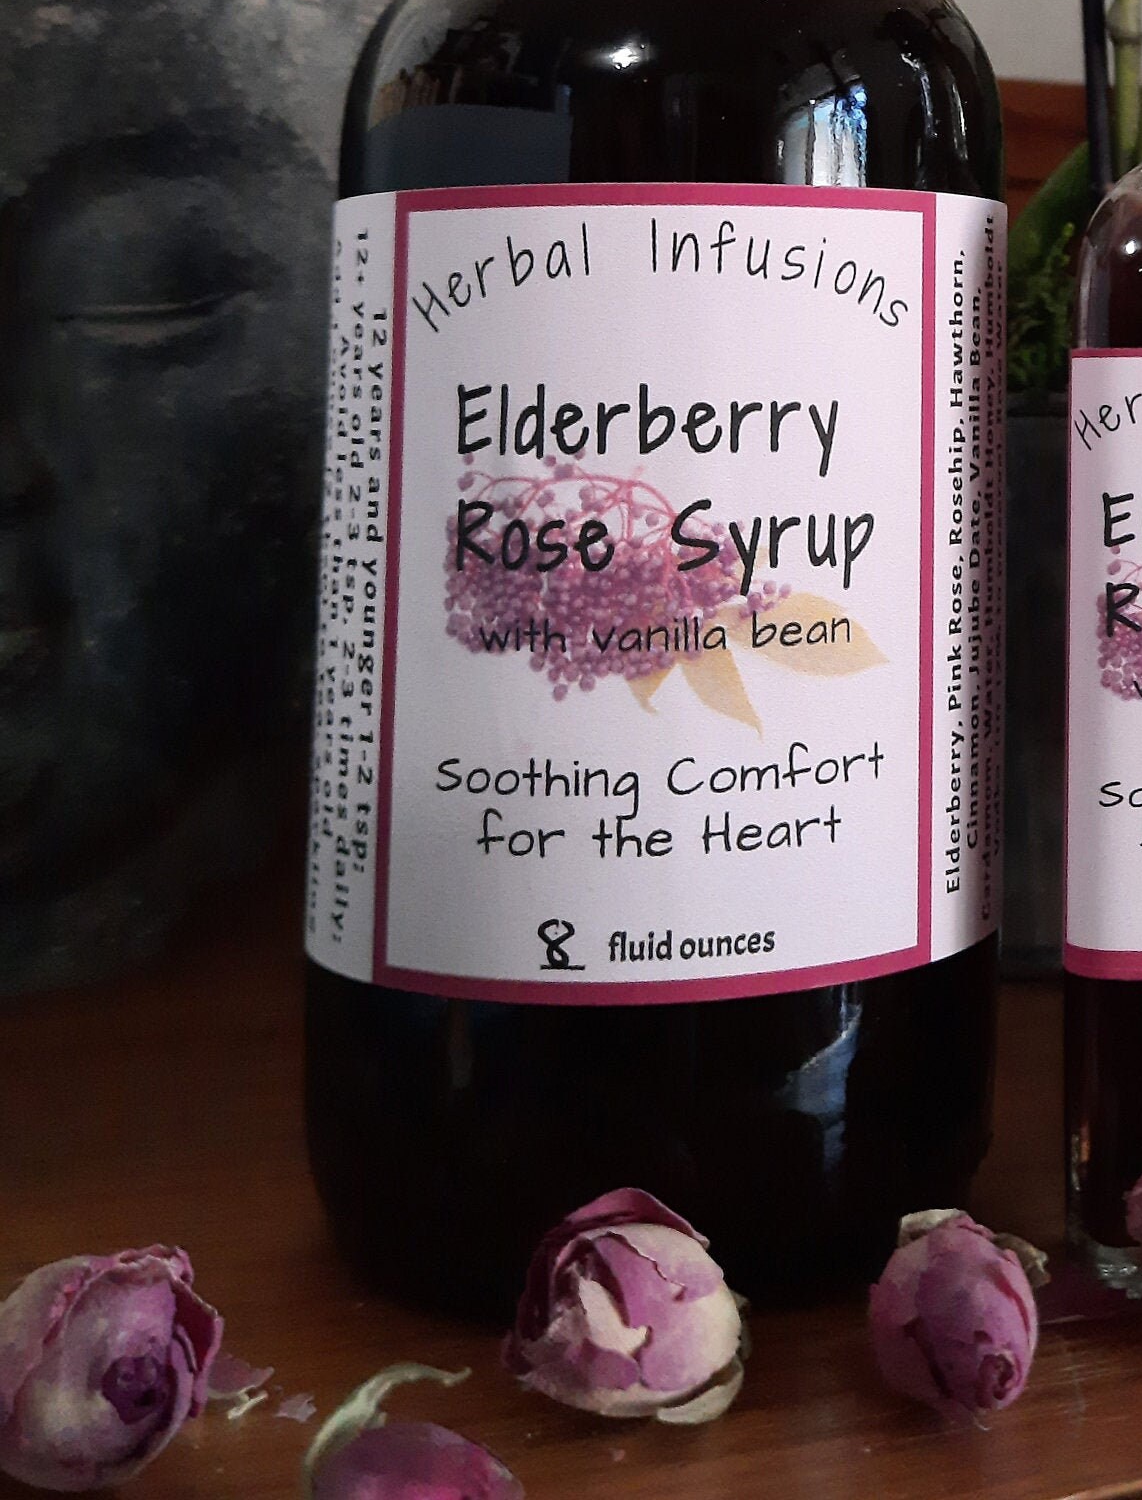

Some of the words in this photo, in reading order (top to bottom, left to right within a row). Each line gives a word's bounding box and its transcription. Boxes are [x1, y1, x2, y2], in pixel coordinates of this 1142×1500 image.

[357, 228, 368, 285] 12+
[412, 221, 592, 333] Herbal
[650, 218, 909, 328] Infusions
[985, 215, 994, 358] Humboldt
[353, 302, 365, 400] years
[373, 308, 387, 347] 12
[949, 250, 965, 408] Hawthorn,
[970, 287, 981, 367] Bean,
[337, 336, 350, 437] Avoid
[368, 362, 383, 461] years
[350, 413, 364, 469] old
[456, 383, 839, 477] Elderberry
[969, 377, 980, 482] Vanilla
[335, 454, 347, 520] less
[348, 485, 361, 540] 2-3
[366, 476, 384, 543] and
[948, 418, 965, 545] Rosehip,
[455, 499, 615, 572] Rose
[670, 499, 875, 596] Syrup
[969, 491, 981, 569] Date,
[984, 479, 993, 627] Humboldt
[331, 539, 343, 620] than
[949, 555, 964, 635] Rose,
[358, 558, 378, 717] younger
[478, 616, 566, 654] with
[592, 616, 728, 653] vanilla
[752, 610, 852, 648] bean
[967, 579, 982, 676] Jujube
[342, 642, 355, 698] 2-3
[947, 645, 961, 711] Pink
[338, 715, 354, 821] times
[357, 730, 374, 785] 1-2
[435, 757, 640, 820] Soothing
[668, 741, 884, 796] Comfort
[967, 684, 980, 850] Cinnamon,
[323, 779, 333, 838] old
[476, 808, 565, 858] for
[592, 816, 673, 858] the
[702, 804, 842, 854] Heart
[946, 720, 965, 894] Elderberry,
[538, 918, 576, 968] 8
[608, 930, 673, 963] fluid
[680, 929, 776, 959] ounces
